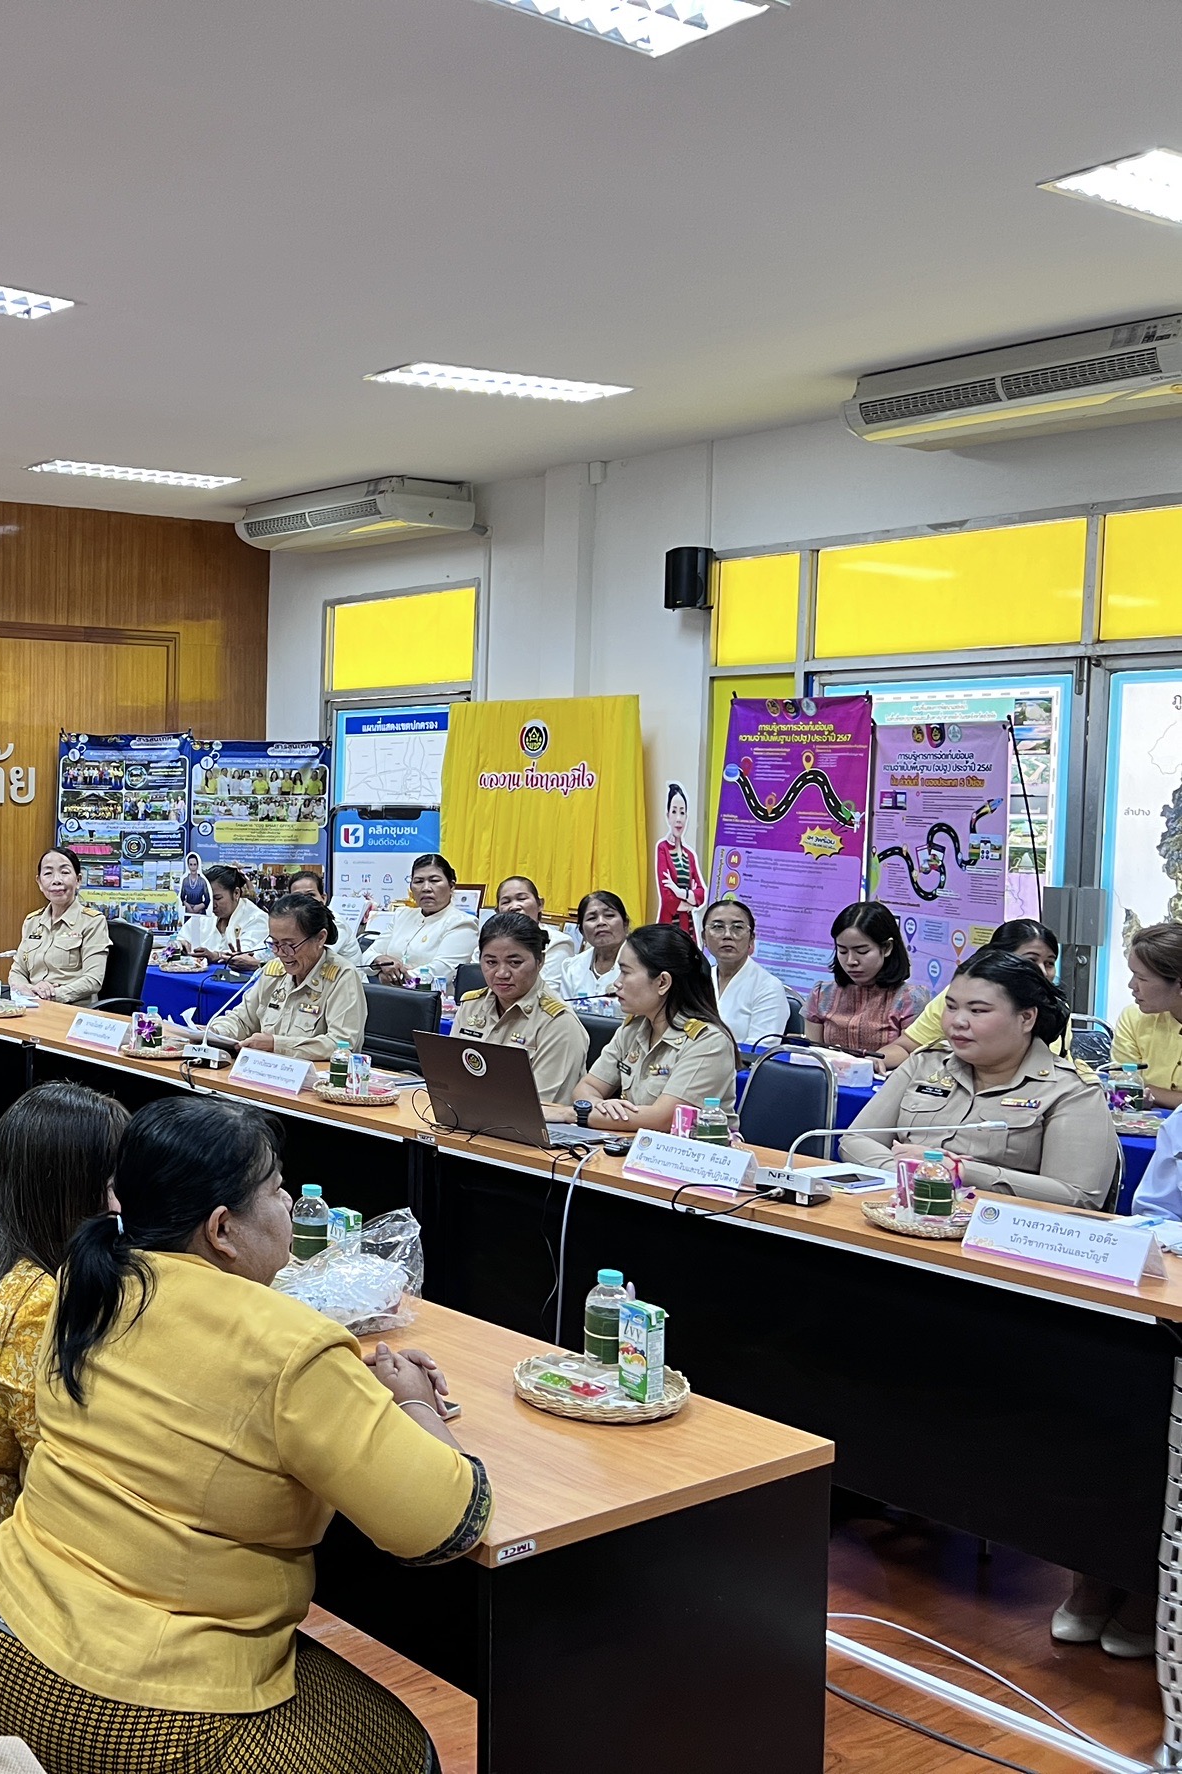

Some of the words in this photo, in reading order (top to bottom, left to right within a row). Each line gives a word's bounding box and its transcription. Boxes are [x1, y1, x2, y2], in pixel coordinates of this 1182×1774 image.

[362, 717, 438, 732] แผนที่แสดงเขตปกครอง
[479, 773, 520, 791] ผลงาน
[1124, 806, 1151, 816] ลำปาง
[368, 825, 418, 838] คลิกชุมชน
[368, 837, 410, 846] ยินดีต้อนรับ
[768, 1171, 795, 1182] NPE
[1010, 1233, 1110, 1263] นักวิชาการเงินและบัญชี
